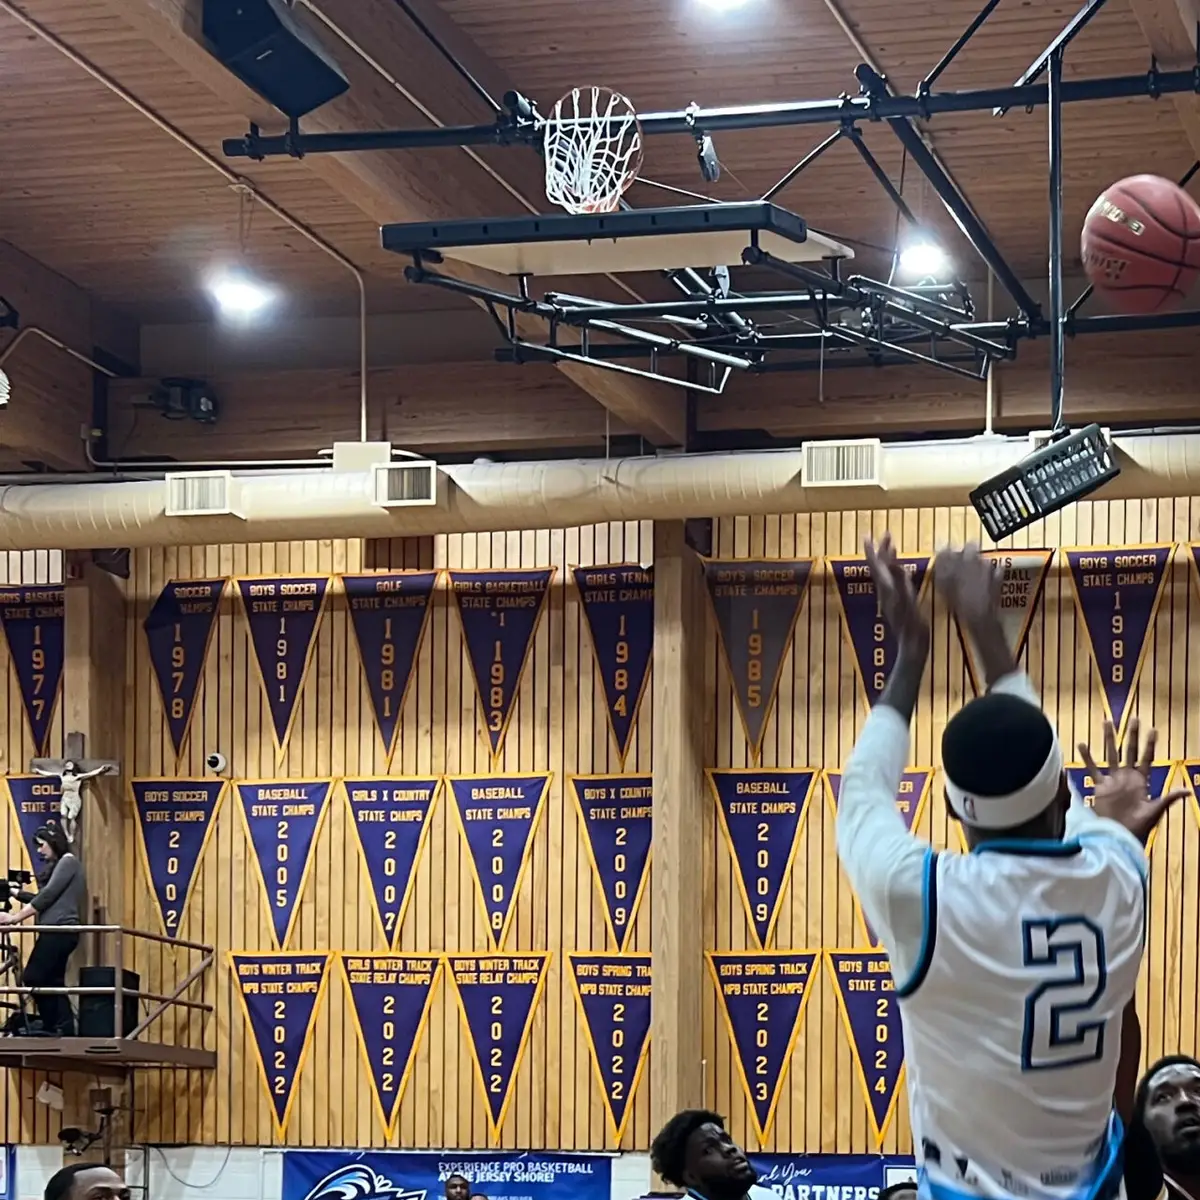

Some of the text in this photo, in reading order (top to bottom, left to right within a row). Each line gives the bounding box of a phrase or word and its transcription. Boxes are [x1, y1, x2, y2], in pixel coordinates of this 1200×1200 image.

[1079, 555, 1157, 569] BOYS SOCCER
[586, 574, 616, 585] GIRLS
[717, 569, 795, 582] BOYS SOCCER
[1083, 573, 1154, 587] STATE CHAMPS
[174, 586, 211, 598] SOCCER
[250, 583, 317, 596] BOYS SOCCER
[376, 581, 402, 592] GOLF
[455, 581, 545, 594] GIRLS BASKETBALL
[715, 584, 798, 596] STATE CHAMPS
[847, 582, 873, 594] STATE
[462, 596, 536, 608] STATE CHAMPS
[585, 589, 653, 602] STATE CHAMP
[252, 600, 314, 613] STATE CHAMPS
[352, 596, 426, 609] STATE CHAMPS
[1112, 591, 1123, 682] 1988
[276, 617, 287, 702] 1981
[747, 609, 761, 707] 1985
[32, 625, 44, 721] 1977
[171, 624, 184, 719] 1978
[381, 618, 394, 717] 1981
[614, 616, 628, 717] 1984
[490, 641, 504, 731] 1983
[258, 789, 308, 800] BASEBALL
[471, 788, 525, 800] BASEBALL
[584, 789, 606, 800] BOYS
[737, 782, 790, 794] BASEBALL
[144, 790, 207, 803] BOYS SOCCER
[393, 789, 430, 801] COUNTRY
[21, 801, 46, 813] STATE
[252, 804, 315, 816] STATE CHAMPS
[465, 807, 531, 820] STATE CHAMPS
[730, 802, 796, 814] STATE CHAMPS
[146, 810, 205, 822] STATE CHAMPS
[358, 810, 423, 822] STATE CHAMPS
[589, 808, 617, 820] STATE
[276, 822, 288, 907] 2005
[166, 831, 180, 927] 2002
[614, 827, 627, 926] 2009
[756, 823, 769, 922] 2009
[384, 831, 397, 930] 2007
[491, 830, 504, 930] 2008
[295, 963, 321, 975] TRACK
[406, 960, 432, 972] TRACK
[513, 959, 539, 971] TRACK
[576, 964, 632, 976] BOYS SPRING
[720, 963, 807, 977] BOYS SPRING TRACK
[839, 961, 862, 973] BOYS
[261, 982, 318, 994] STATE CHAMPS
[599, 983, 652, 996] STATE CHAMP
[743, 983, 804, 996] STATE CHAMPS
[848, 979, 876, 991] STATE
[1021, 914, 1107, 1075] 2
[274, 1001, 286, 1095] 2022
[756, 1003, 768, 1101] 2023
[438, 1161, 594, 1174] EXPERIENCE PRO BASKETBALL
[781, 1162, 812, 1186] You
[475, 1172, 510, 1183] JERSEY
[513, 1171, 555, 1183] SHORE!
